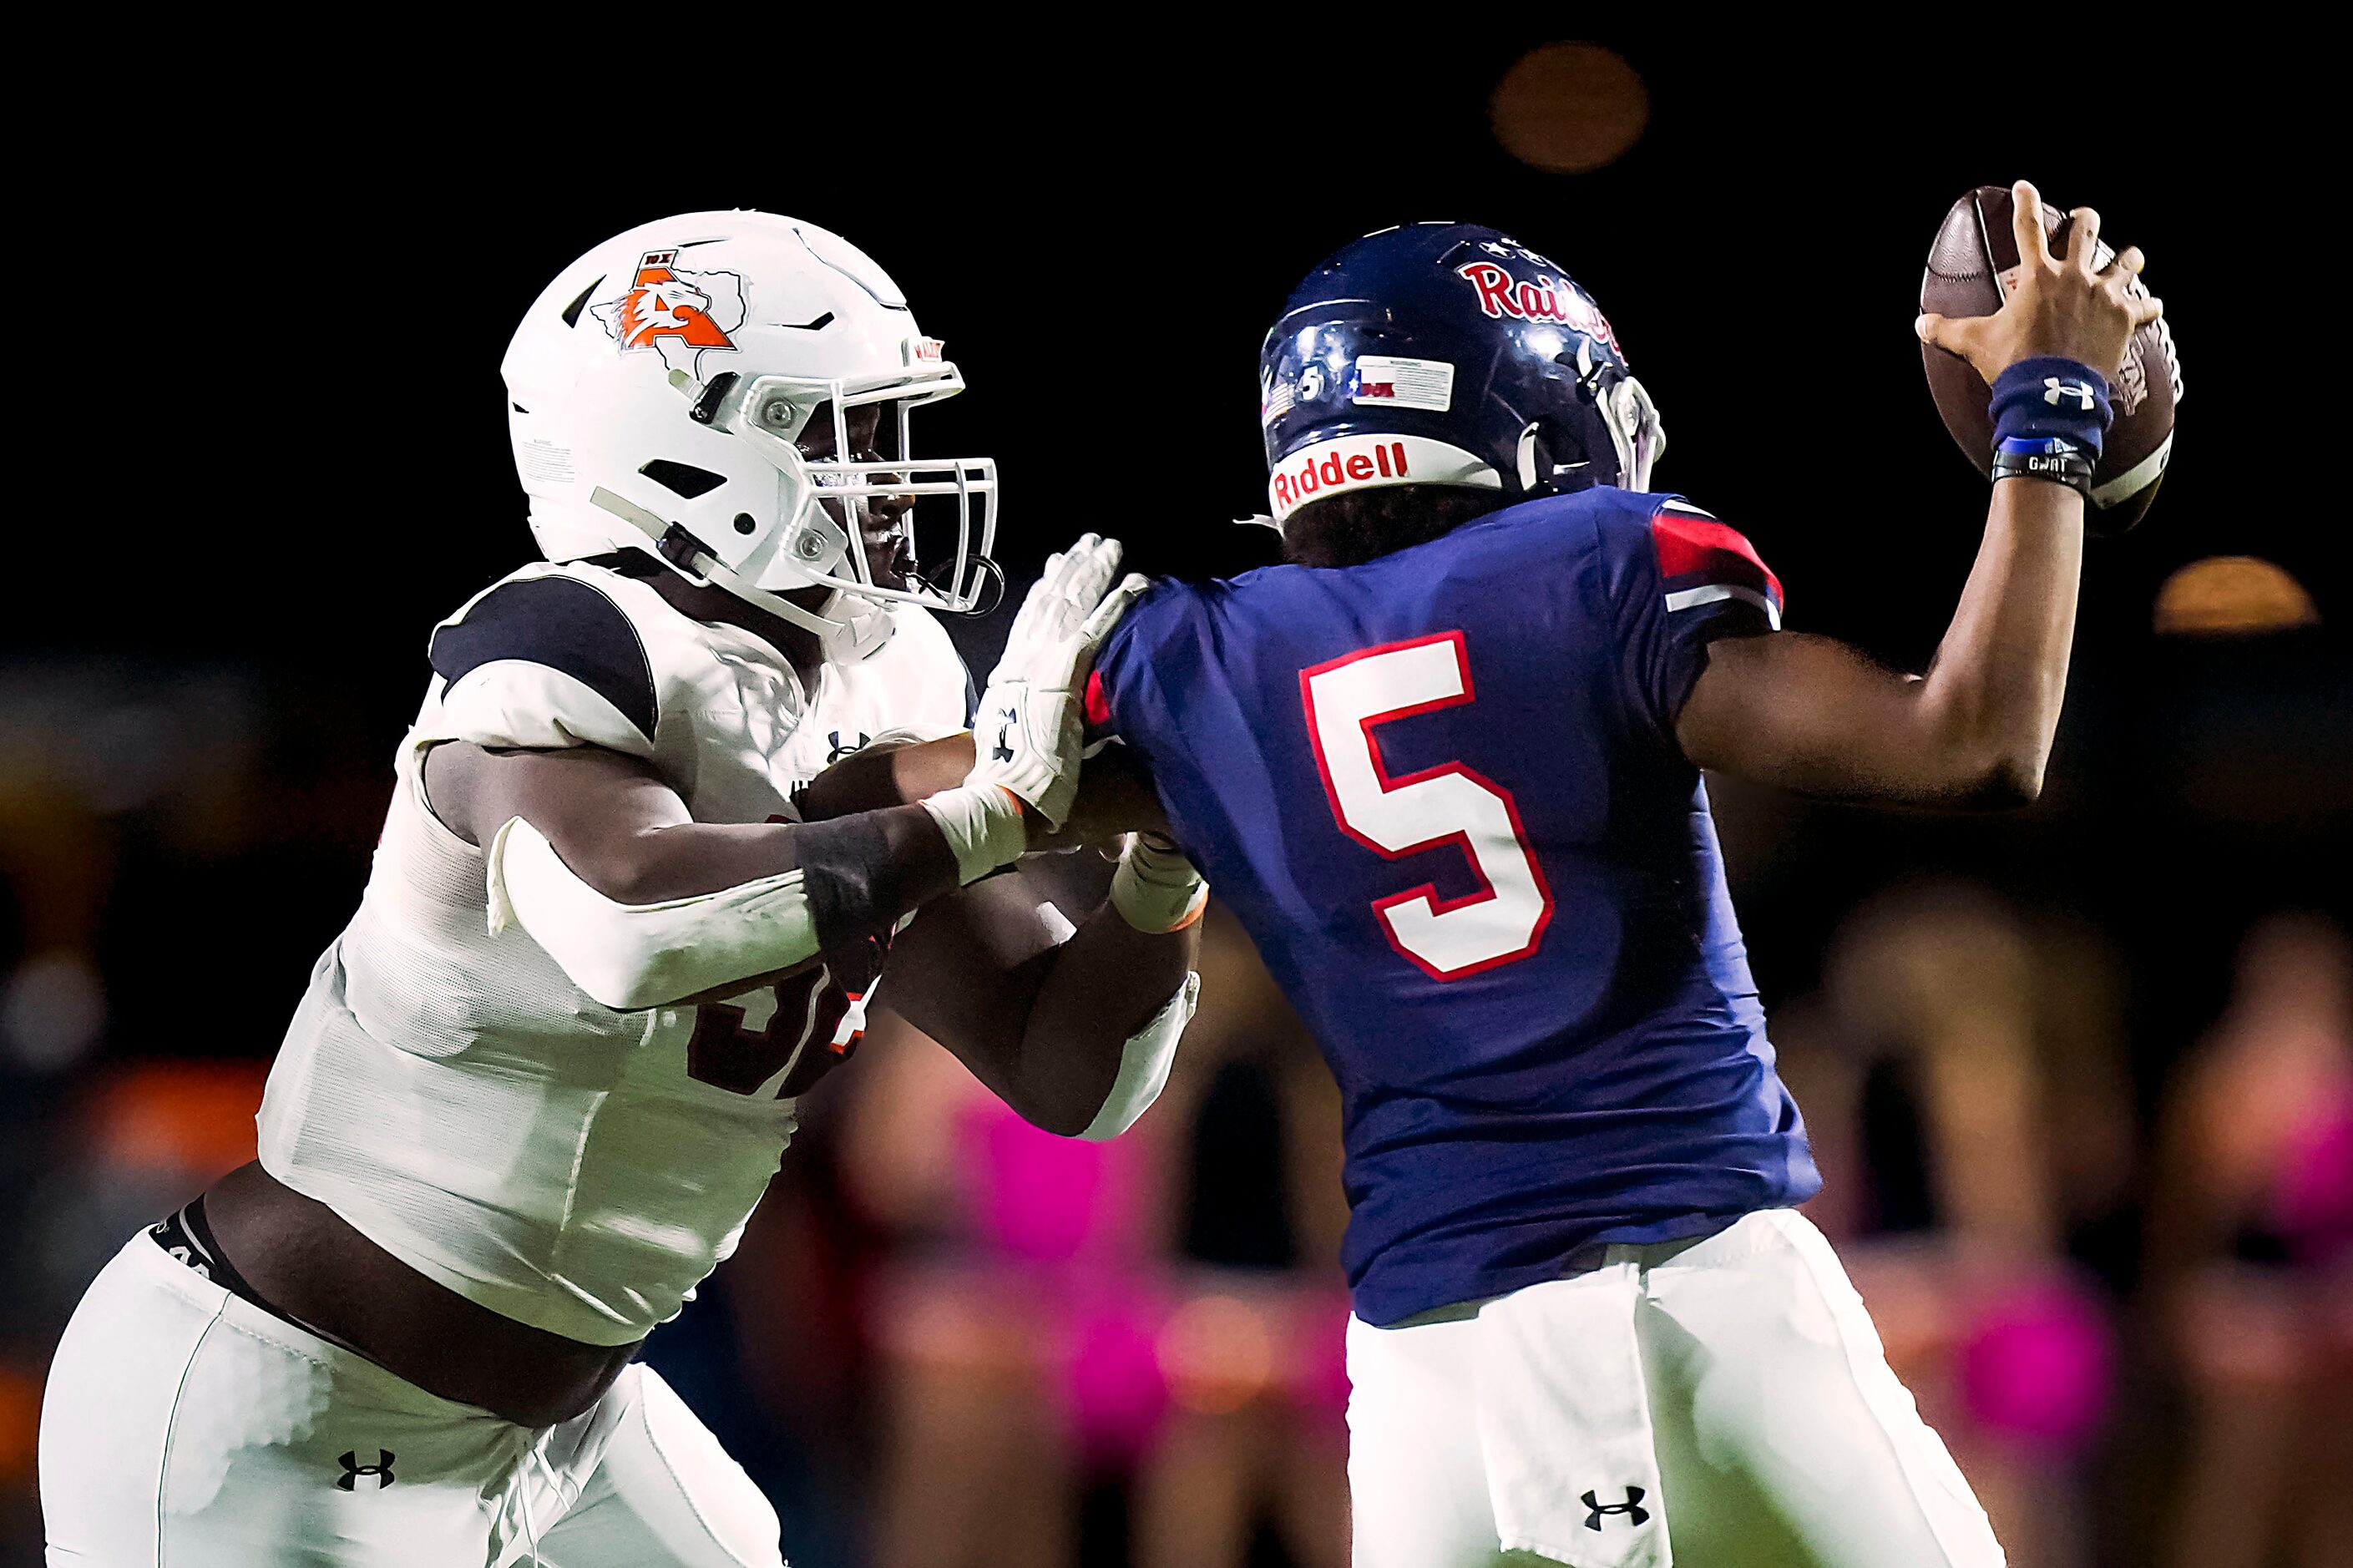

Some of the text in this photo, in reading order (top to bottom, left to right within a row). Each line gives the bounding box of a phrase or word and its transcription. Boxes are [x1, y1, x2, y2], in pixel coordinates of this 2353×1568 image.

[1302, 365, 1324, 401] 5
[1274, 442, 1408, 509] Riddell
[1298, 630, 1555, 982] 5
